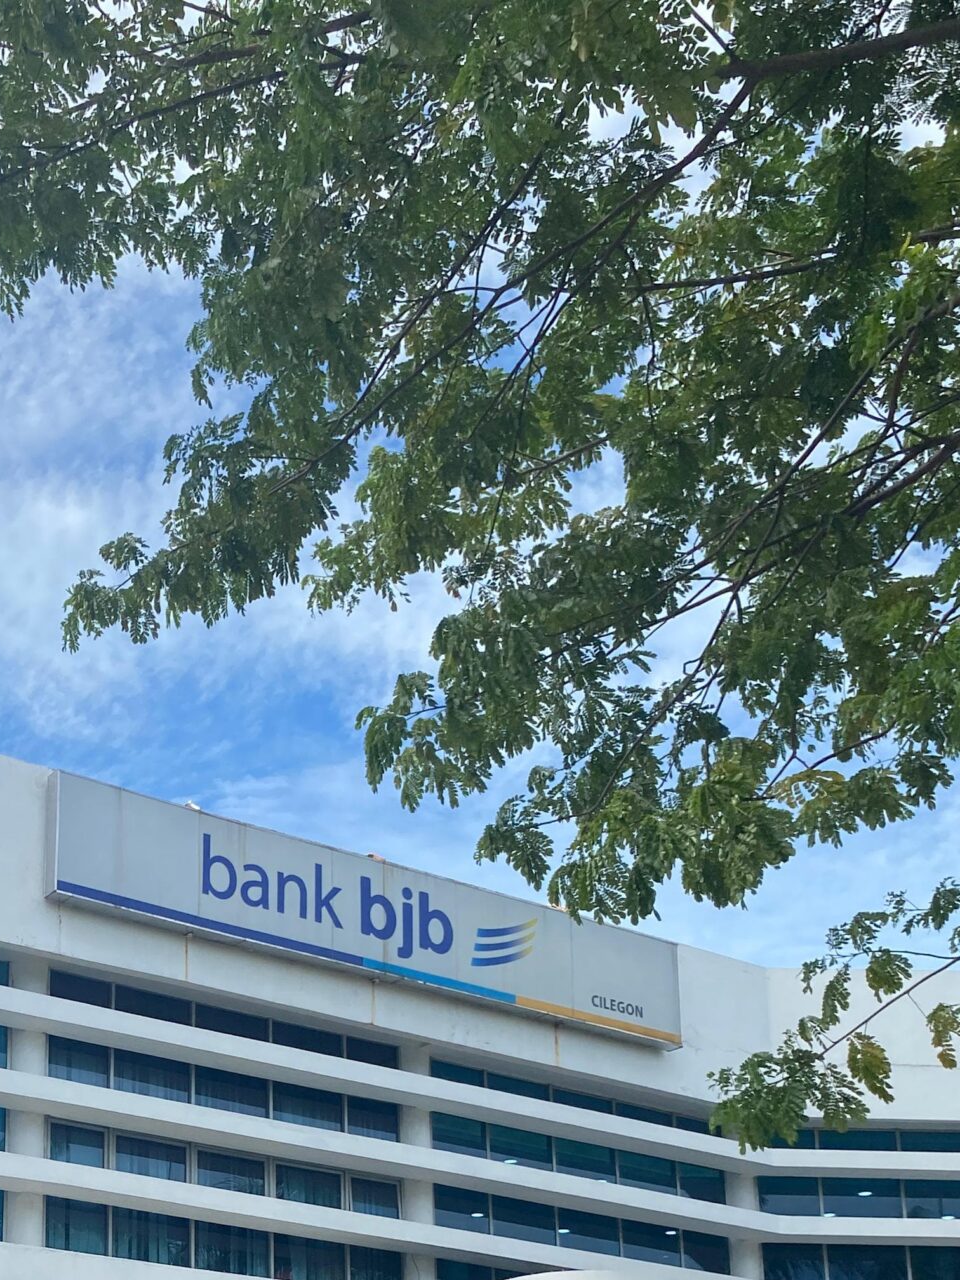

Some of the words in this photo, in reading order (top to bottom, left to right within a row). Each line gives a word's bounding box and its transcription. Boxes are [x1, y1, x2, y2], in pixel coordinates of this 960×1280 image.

[202, 833, 343, 929] bank
[360, 876, 454, 959] bjb
[591, 995, 644, 1018] CILEGON
